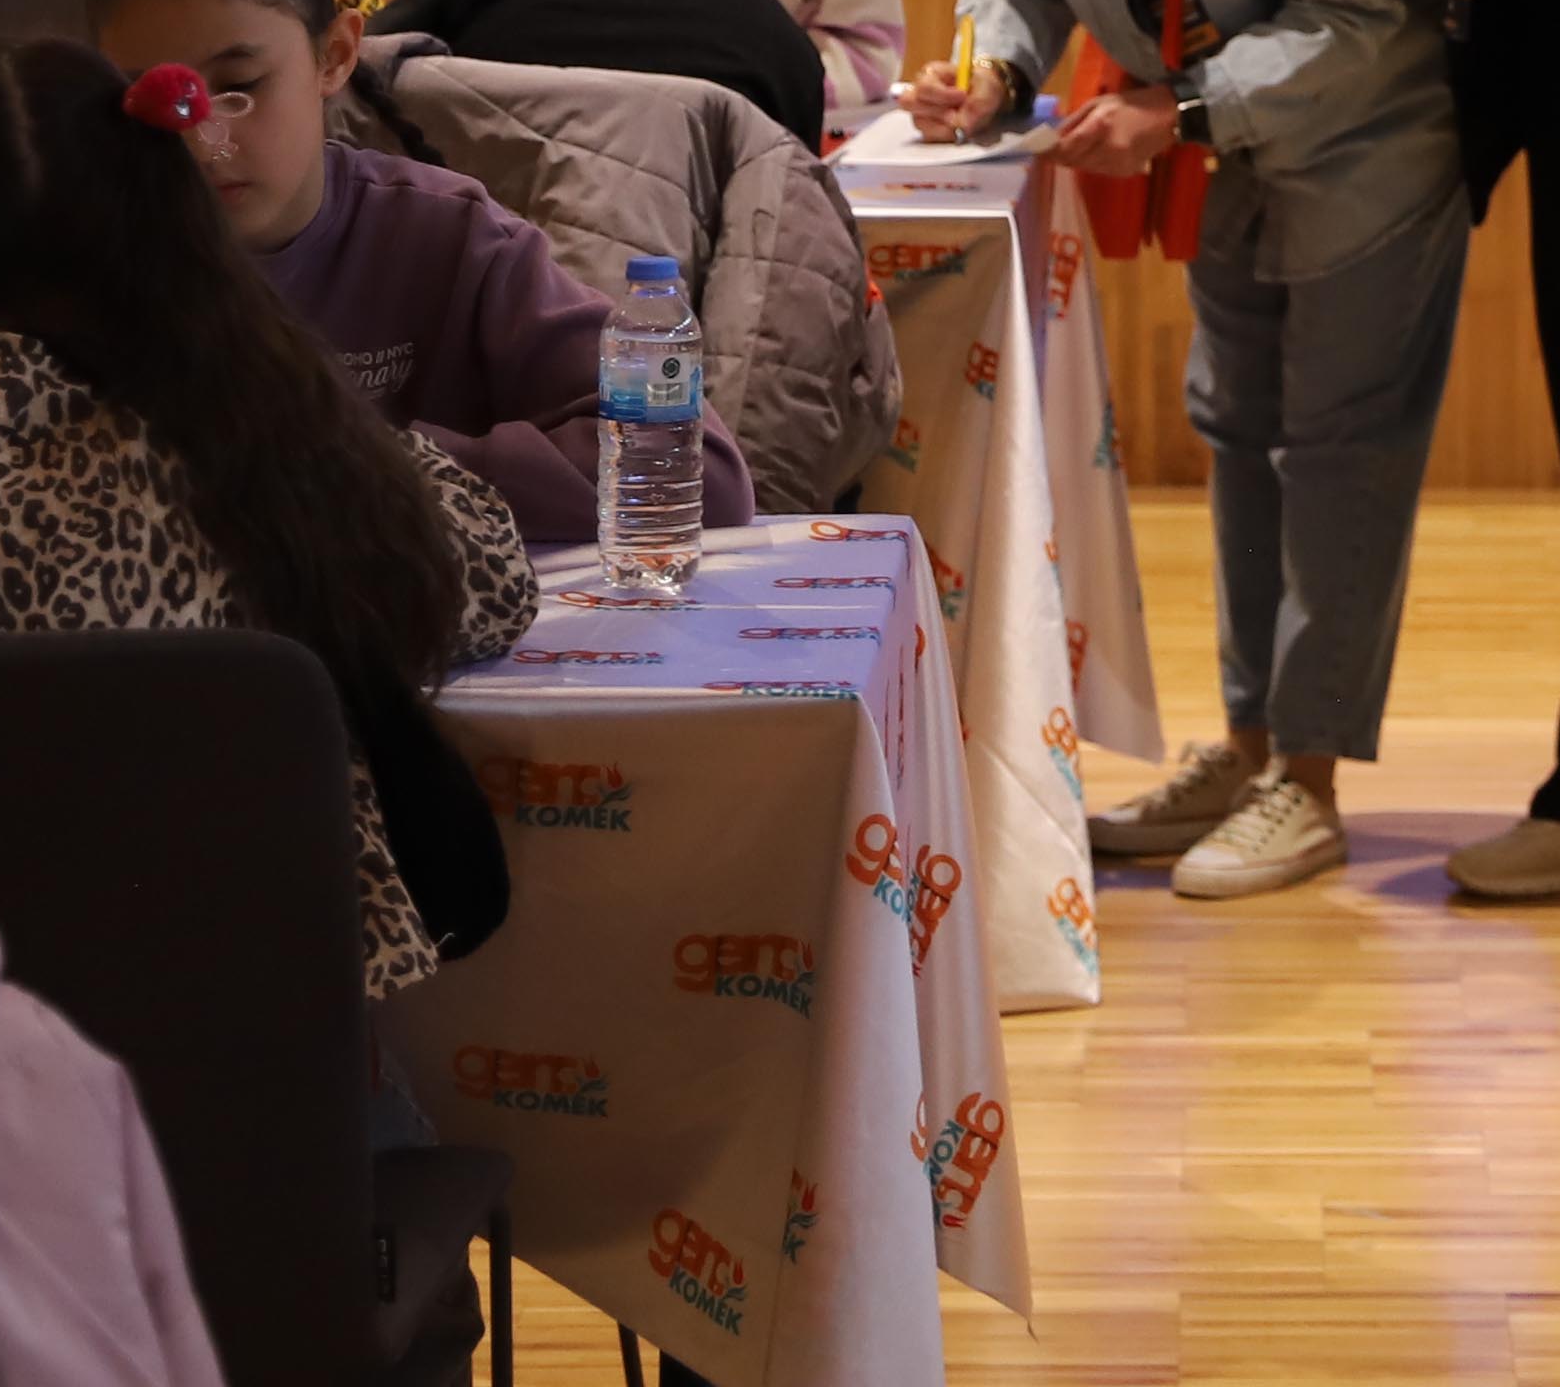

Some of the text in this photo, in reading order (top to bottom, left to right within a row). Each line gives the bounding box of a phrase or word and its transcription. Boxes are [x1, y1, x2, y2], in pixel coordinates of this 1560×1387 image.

[514, 803, 632, 832] KOMEK
[713, 974, 814, 1020] KOMEK
[492, 1089, 609, 1118] KOMEK
[668, 1265, 746, 1336] KOMEK
